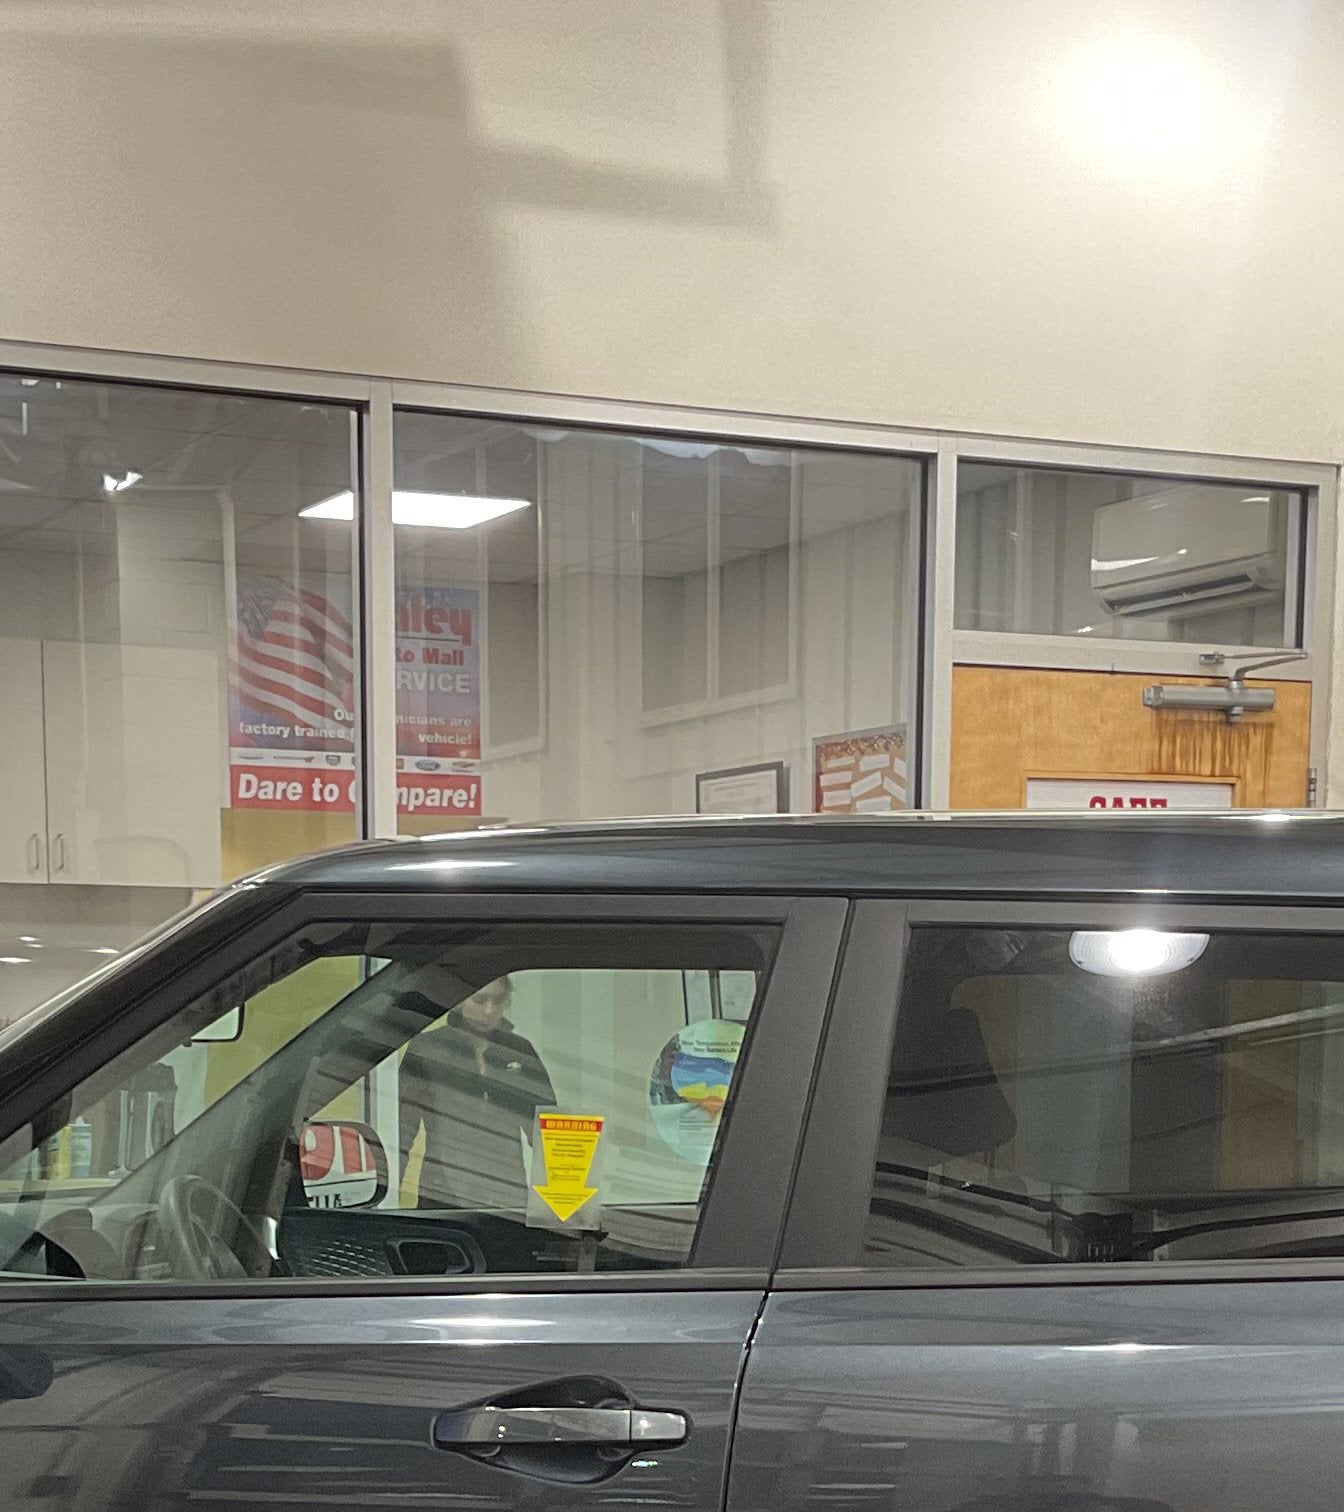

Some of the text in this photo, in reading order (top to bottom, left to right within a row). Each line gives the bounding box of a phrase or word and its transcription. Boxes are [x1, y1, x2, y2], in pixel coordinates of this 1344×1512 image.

[422, 648, 465, 666] Mall
[397, 670, 470, 694] RVICE
[239, 721, 290, 738] factory
[294, 725, 345, 738] trained
[418, 731, 472, 745] vehicle!
[449, 718, 472, 728] are
[238, 773, 303, 801] Dare
[312, 777, 339, 803] to
[545, 1119, 598, 1131] WARNING
